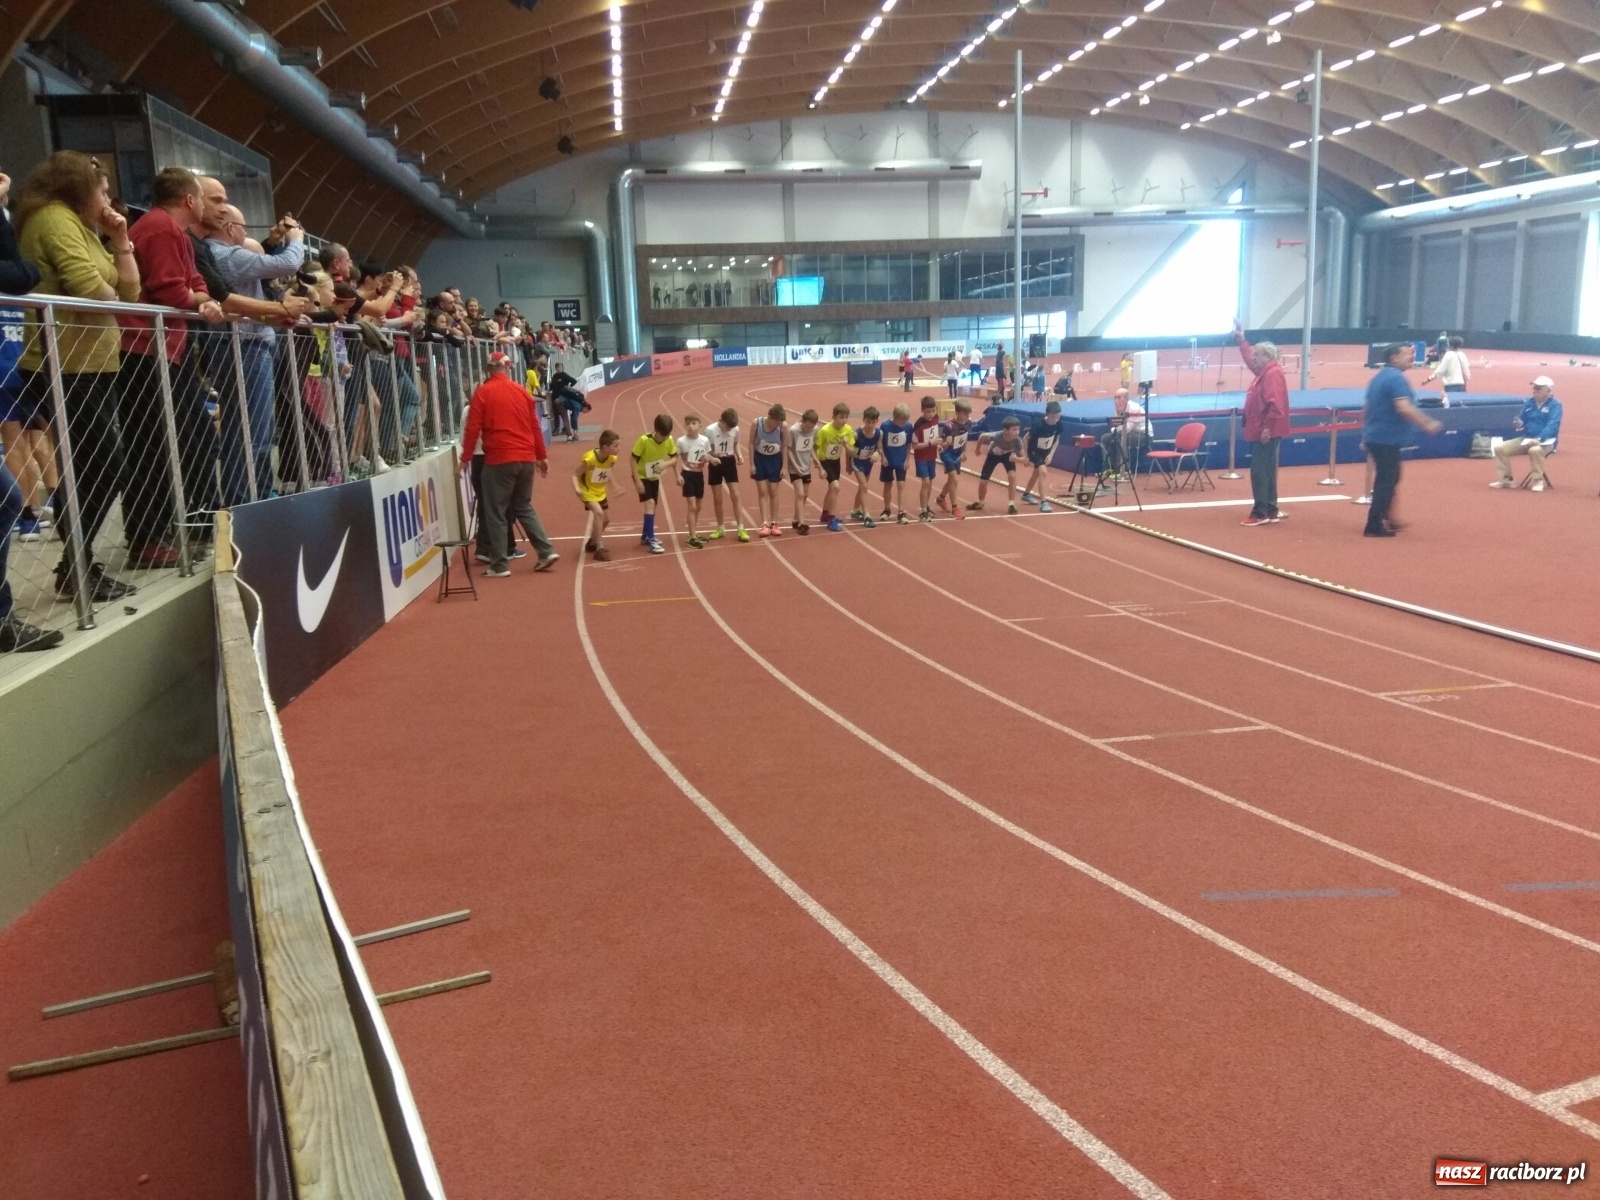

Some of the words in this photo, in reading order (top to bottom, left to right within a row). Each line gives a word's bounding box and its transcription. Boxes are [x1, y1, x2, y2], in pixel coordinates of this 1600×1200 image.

[560, 309, 577, 318] WC
[714, 352, 747, 362] HOLLANDIA
[929, 427, 935, 439] 5
[802, 438, 810, 449] 9
[891, 434, 900, 444] 6
[958, 437, 965, 445] 4
[719, 441, 729, 453] 11
[762, 444, 775, 453] 10
[830, 445, 839, 456] 8
[597, 471, 608, 481] 14
